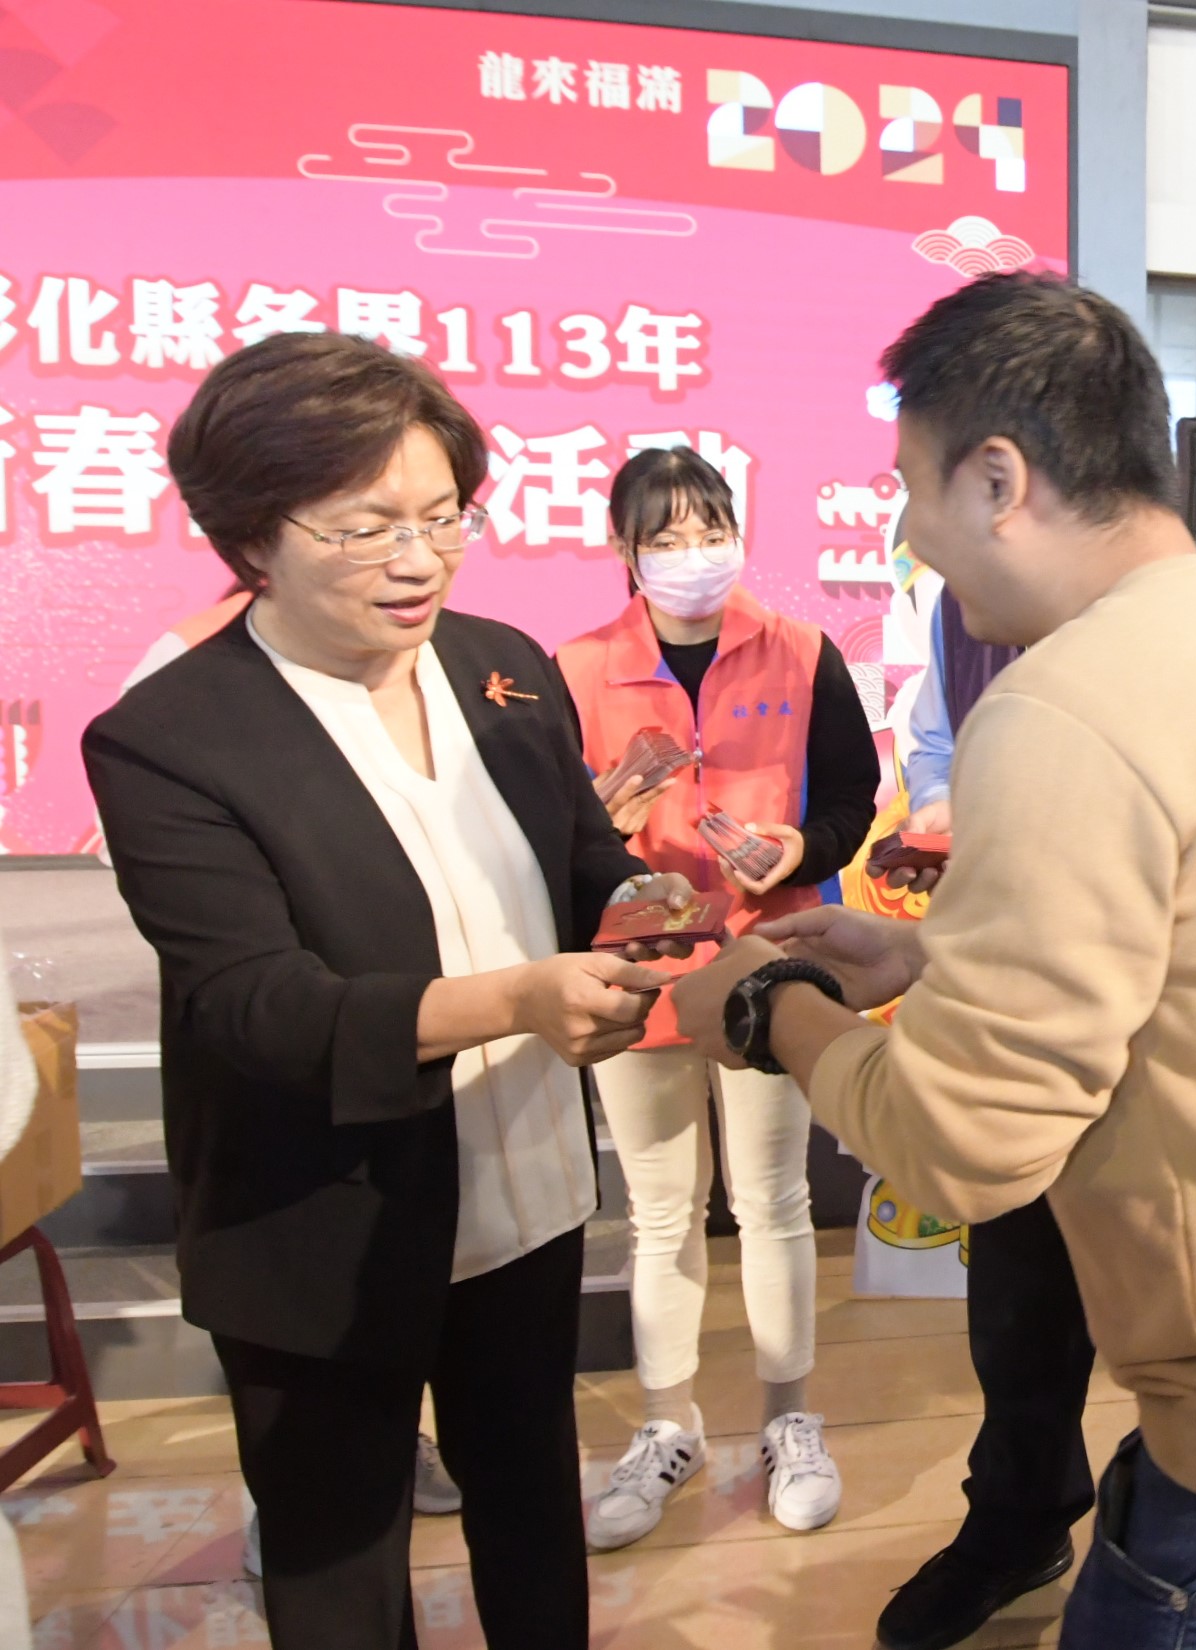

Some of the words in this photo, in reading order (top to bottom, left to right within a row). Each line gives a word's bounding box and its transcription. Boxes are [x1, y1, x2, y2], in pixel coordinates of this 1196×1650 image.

[477, 50, 683, 114] 龍來福滿
[706, 68, 1026, 193] 2024
